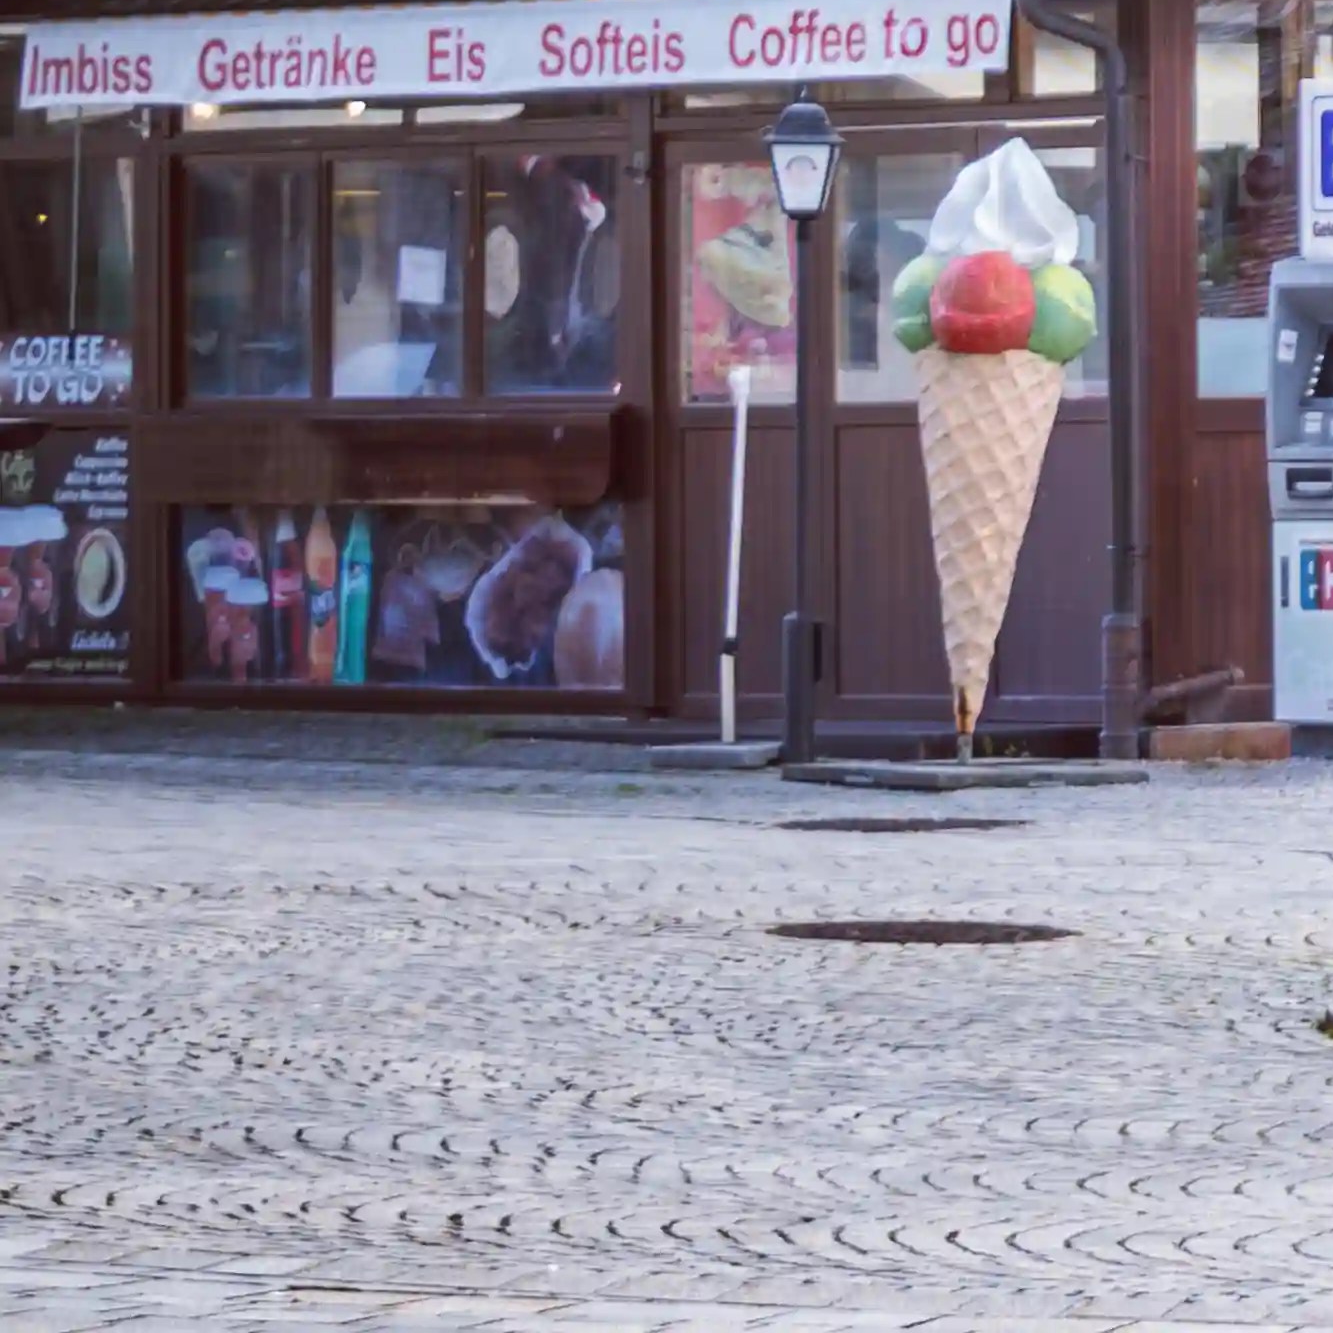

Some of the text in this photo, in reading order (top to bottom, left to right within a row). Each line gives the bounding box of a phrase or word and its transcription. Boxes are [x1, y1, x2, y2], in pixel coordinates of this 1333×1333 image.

[27, 8, 1000, 97] Imbiss Getränke Eis Softeis Coffee to go
[11, 370, 104, 406] TO GO
